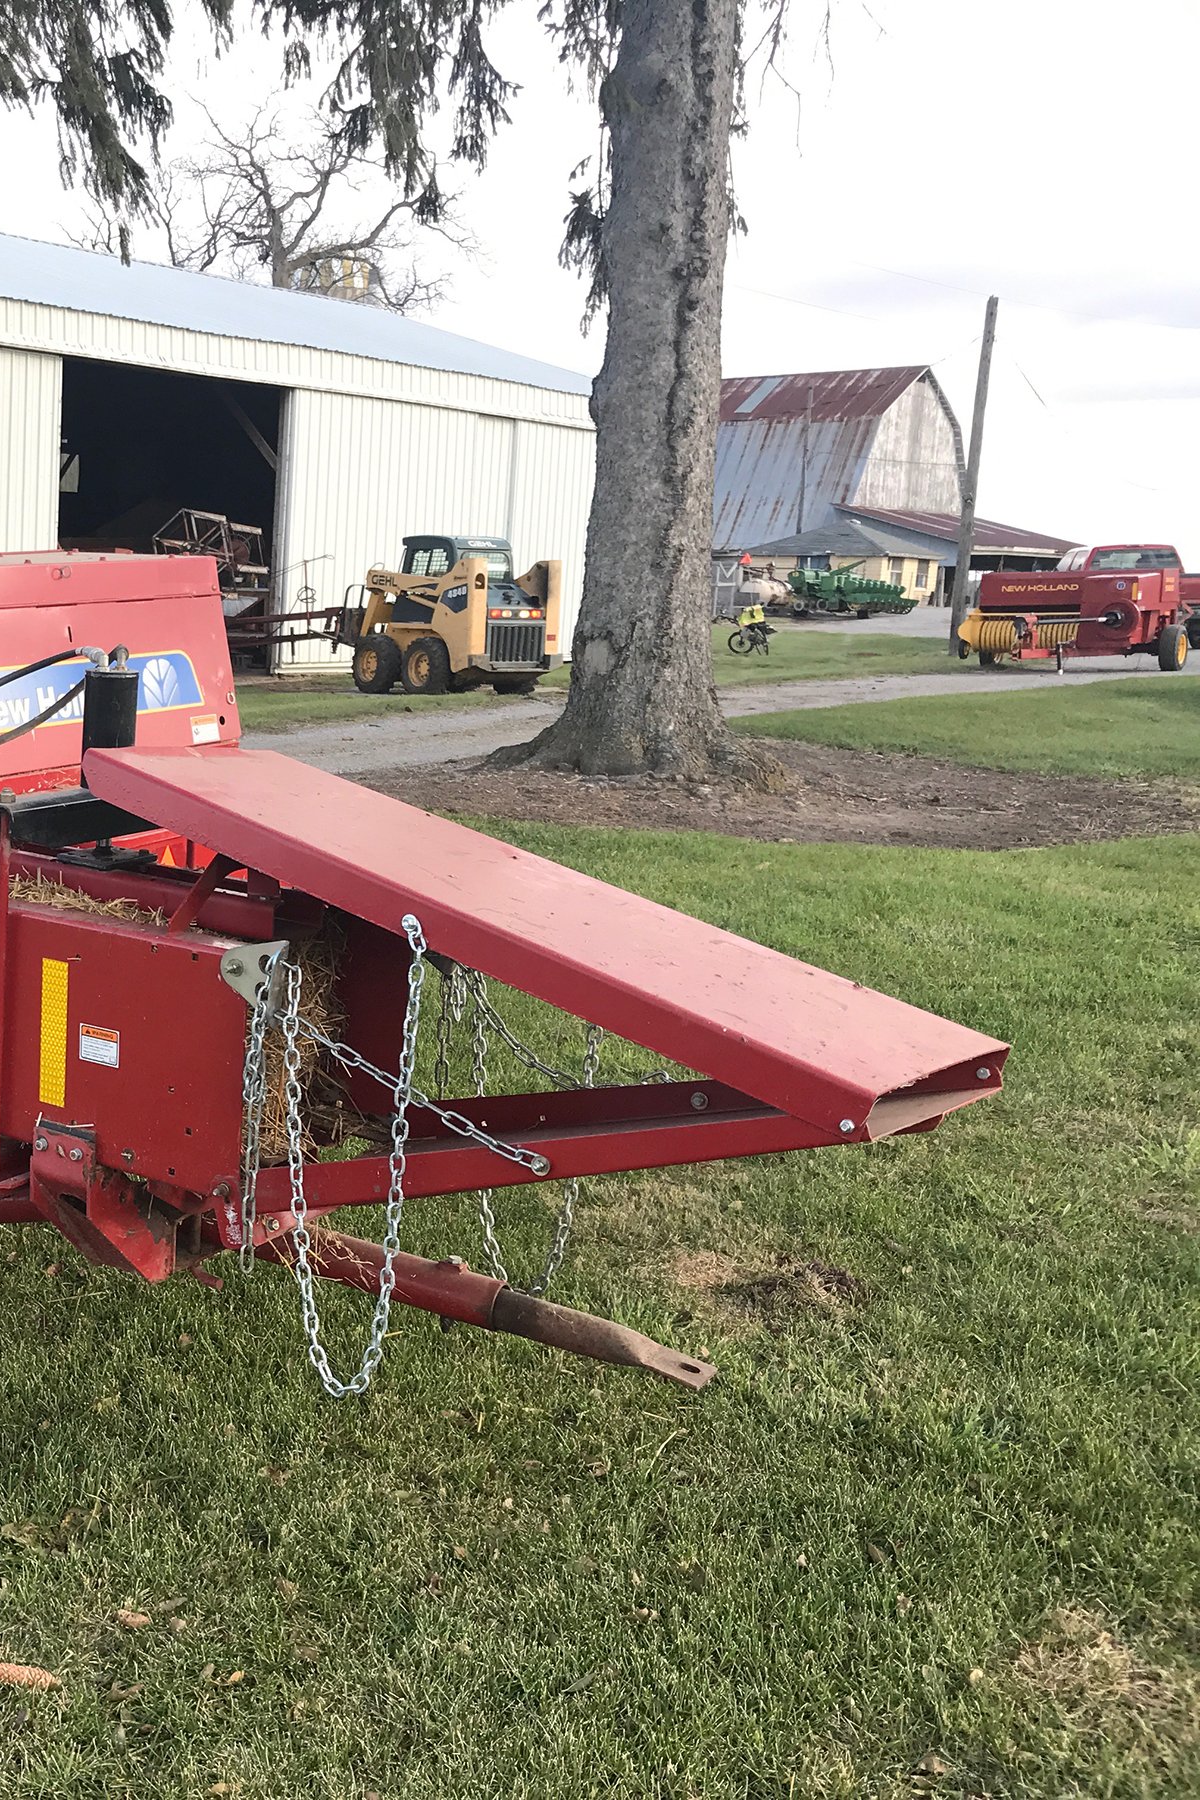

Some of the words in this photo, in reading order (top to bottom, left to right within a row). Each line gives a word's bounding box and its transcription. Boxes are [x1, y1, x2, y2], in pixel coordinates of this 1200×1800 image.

[467, 540, 497, 548] GEHL
[371, 574, 398, 587] GEHL
[1001, 585, 1026, 593] NEW
[1027, 583, 1079, 592] HOLLAND
